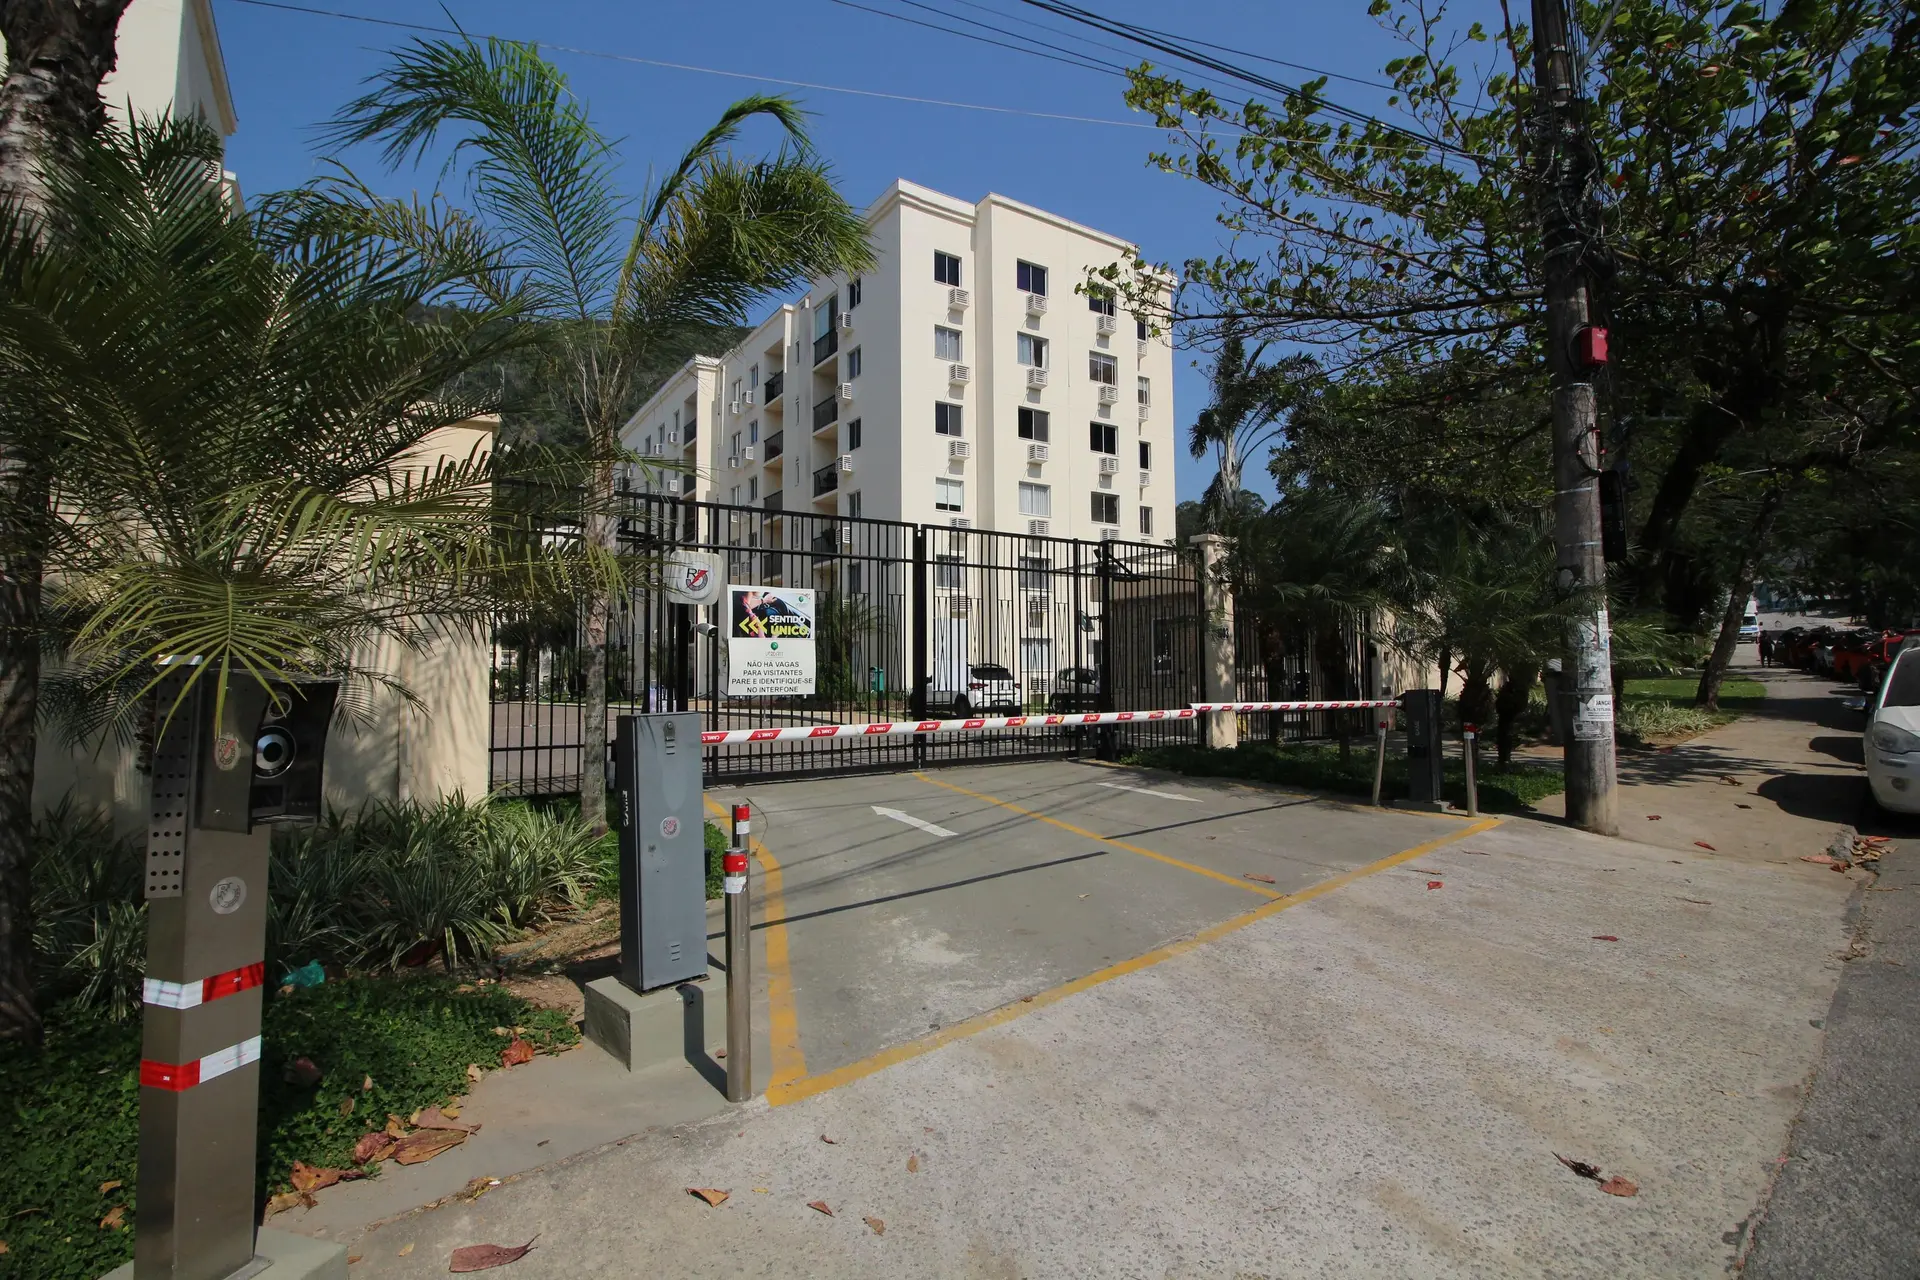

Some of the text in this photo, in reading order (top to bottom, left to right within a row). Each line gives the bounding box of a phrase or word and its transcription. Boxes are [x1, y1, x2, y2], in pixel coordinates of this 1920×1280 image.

[769, 615, 805, 623] SENTIDO
[771, 623, 808, 635] ÚNICO
[747, 660, 762, 668] NÃO
[764, 660, 773, 668] HÁ
[758, 677, 813, 685] IDENTIFIQUE-SE
